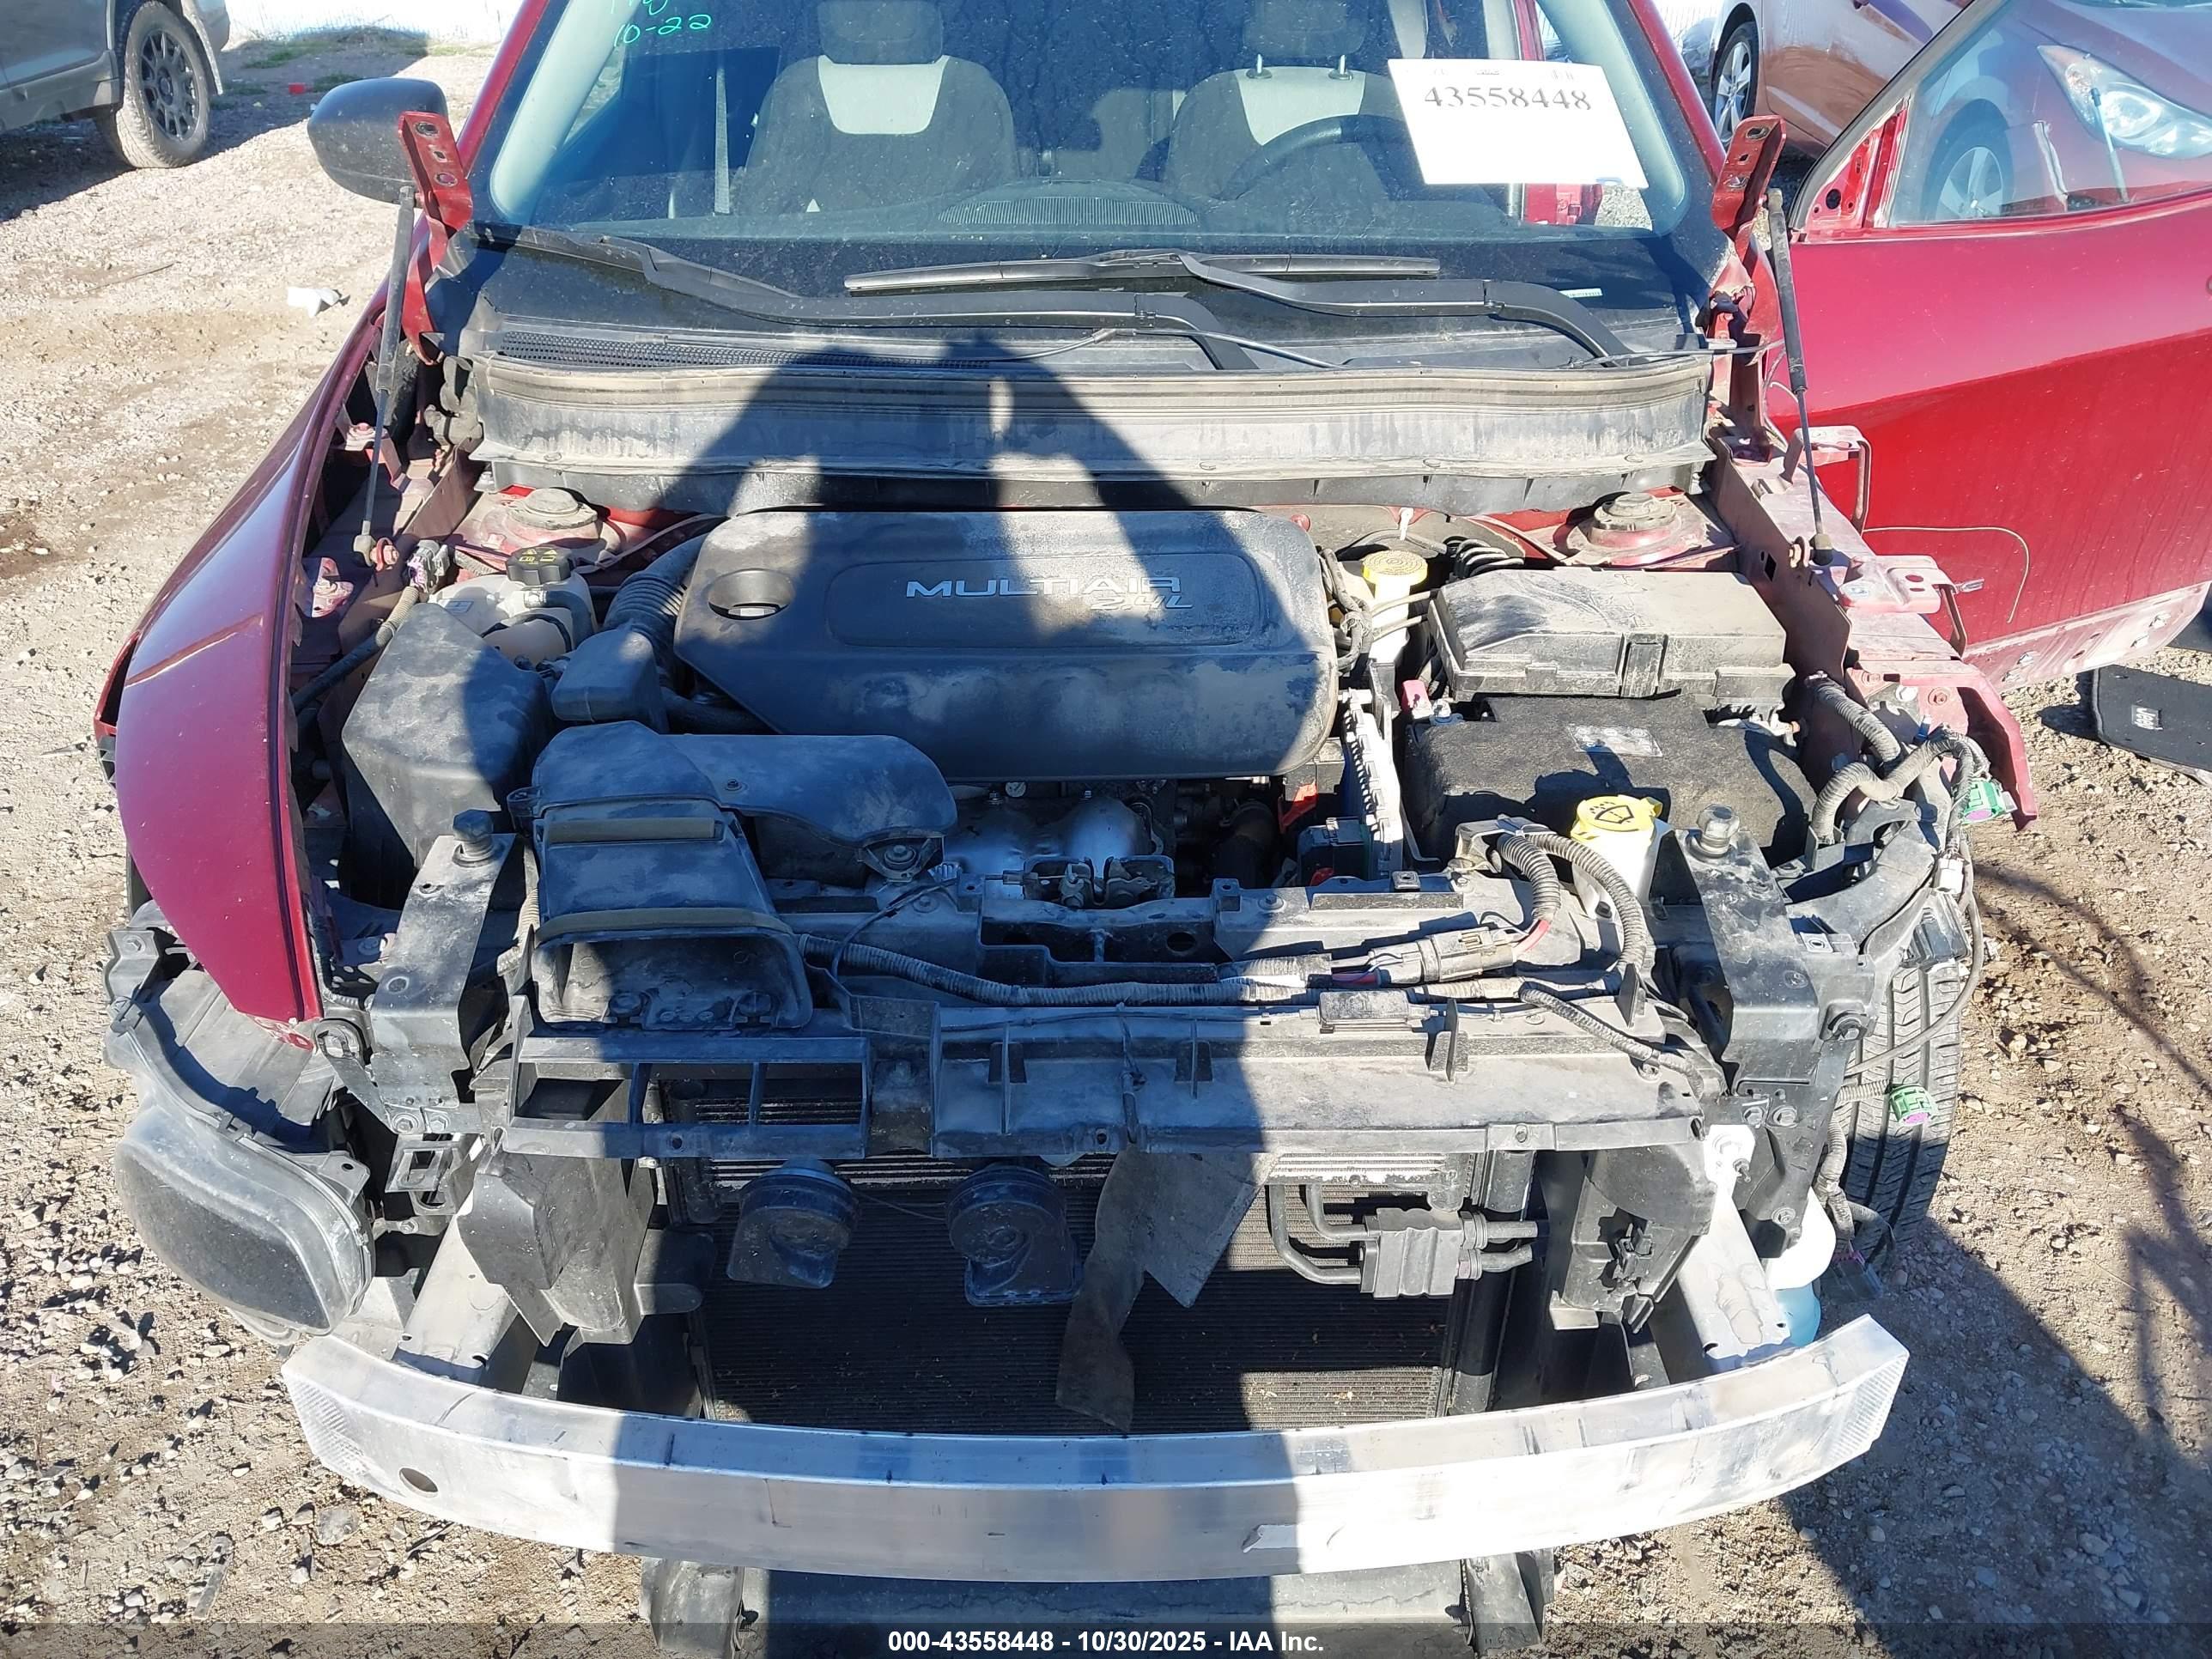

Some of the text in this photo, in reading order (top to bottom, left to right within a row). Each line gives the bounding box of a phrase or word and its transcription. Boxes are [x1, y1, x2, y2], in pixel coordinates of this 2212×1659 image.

[614, 14, 711, 46] 10-22
[1425, 86, 1591, 110] 43558448
[906, 577, 1182, 597] MULTIAIR
[1090, 595, 1194, 610] 2.4L
[2134, 708, 2156, 730] Jeep
